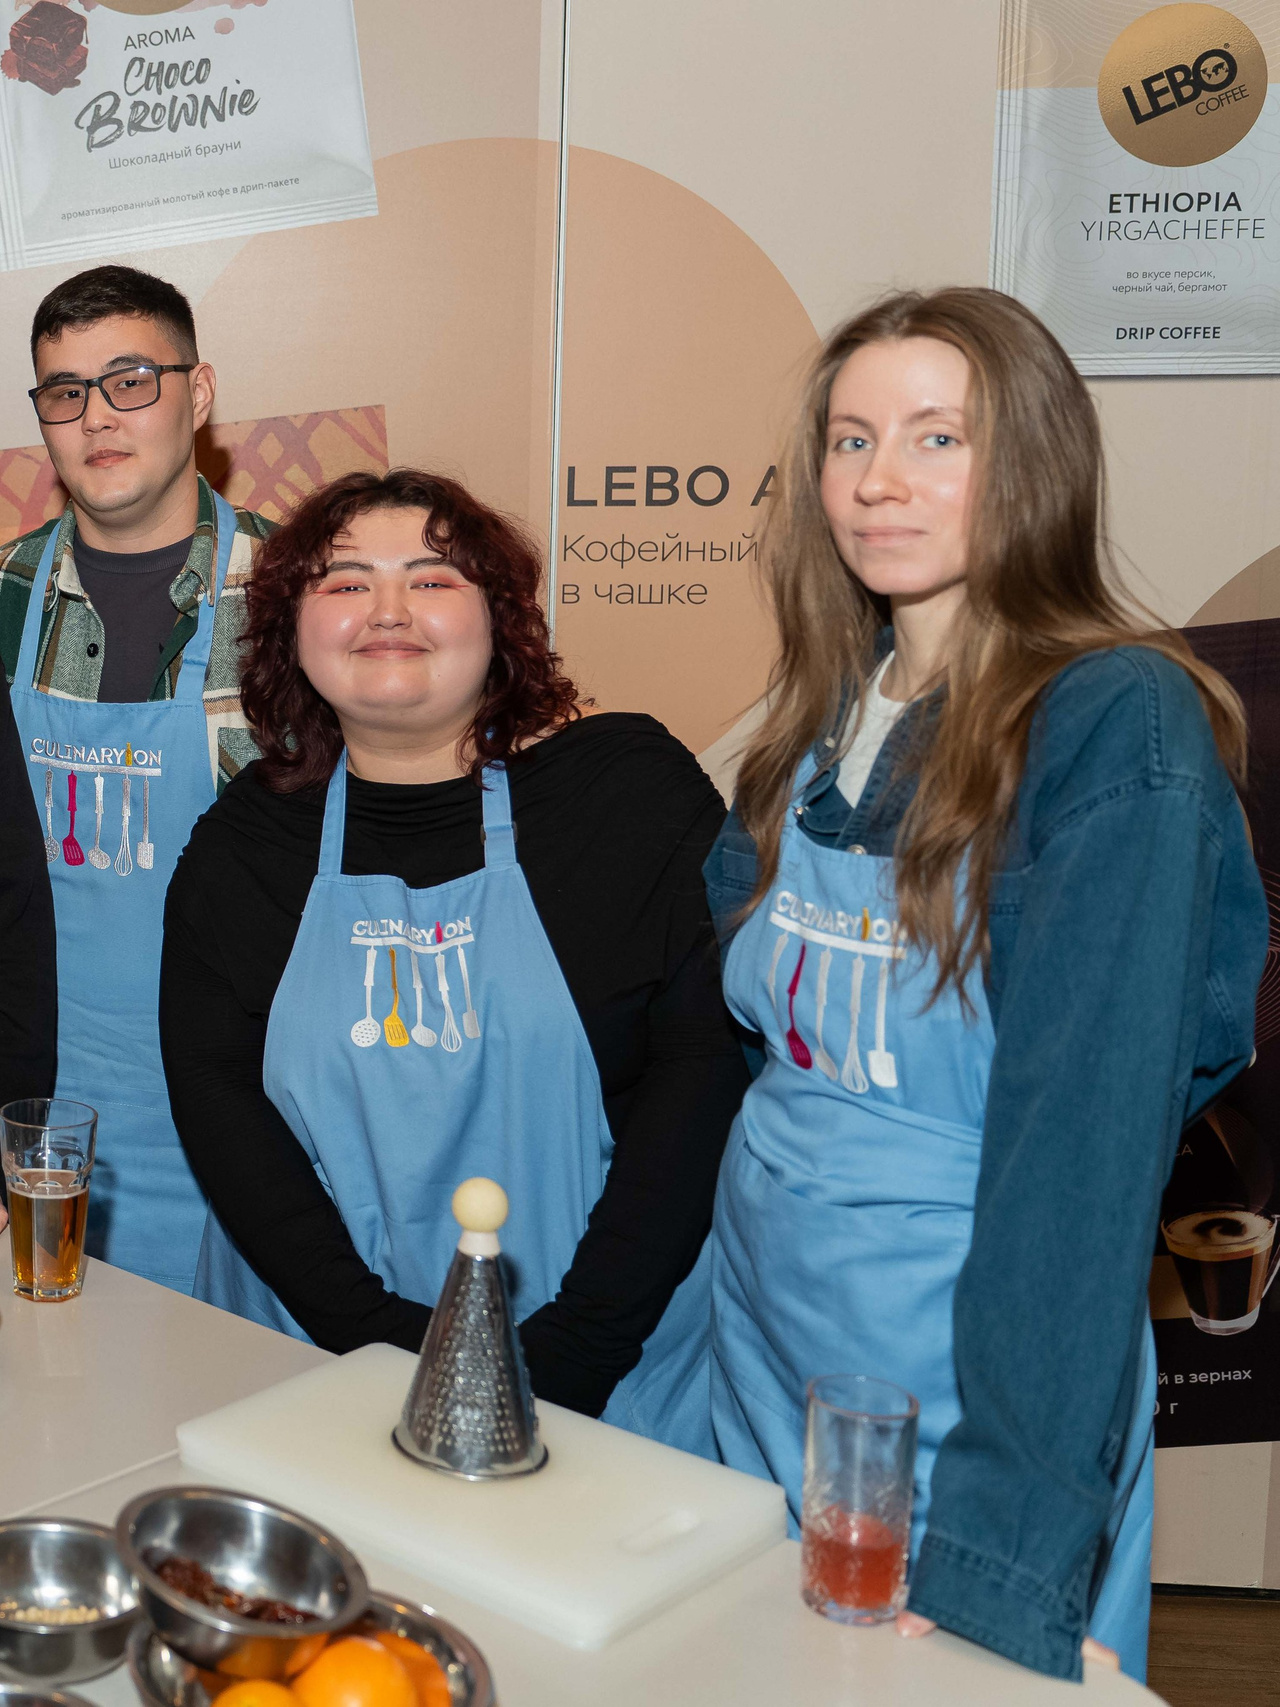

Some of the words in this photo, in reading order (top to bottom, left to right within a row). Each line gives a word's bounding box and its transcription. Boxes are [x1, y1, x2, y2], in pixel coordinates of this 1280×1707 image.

[123, 26, 196, 51] AROMA
[1122, 48, 1238, 125] LEBO
[1195, 84, 1250, 116] COFFEE
[108, 145, 192, 169] Шоколадный
[195, 140, 242, 157] брауни
[60, 197, 160, 220] ароматизированный
[162, 190, 205, 205] молотый
[207, 187, 231, 199] кофе
[232, 186, 239, 194] в
[240, 176, 300, 194] дрип-пакете
[1108, 191, 1242, 214] ETHIOPIA
[1080, 218, 1266, 241] YIRGACHEFFE
[1126, 271, 1139, 279] во
[1142, 271, 1171, 281] вкусе
[1174, 270, 1216, 280] персик,
[1112, 283, 1152, 294] черный
[1155, 282, 1176, 293] чай,
[1177, 282, 1228, 294] бергамот
[1116, 327, 1155, 340] DRIP
[1159, 326, 1221, 340] COFFEE
[566, 465, 730, 507] LEBO
[563, 532, 758, 569] Кофейный
[561, 583, 580, 605] в
[594, 582, 708, 605] чашке
[1174, 1374, 1184, 1384] в
[1188, 1369, 1252, 1385] зернах
